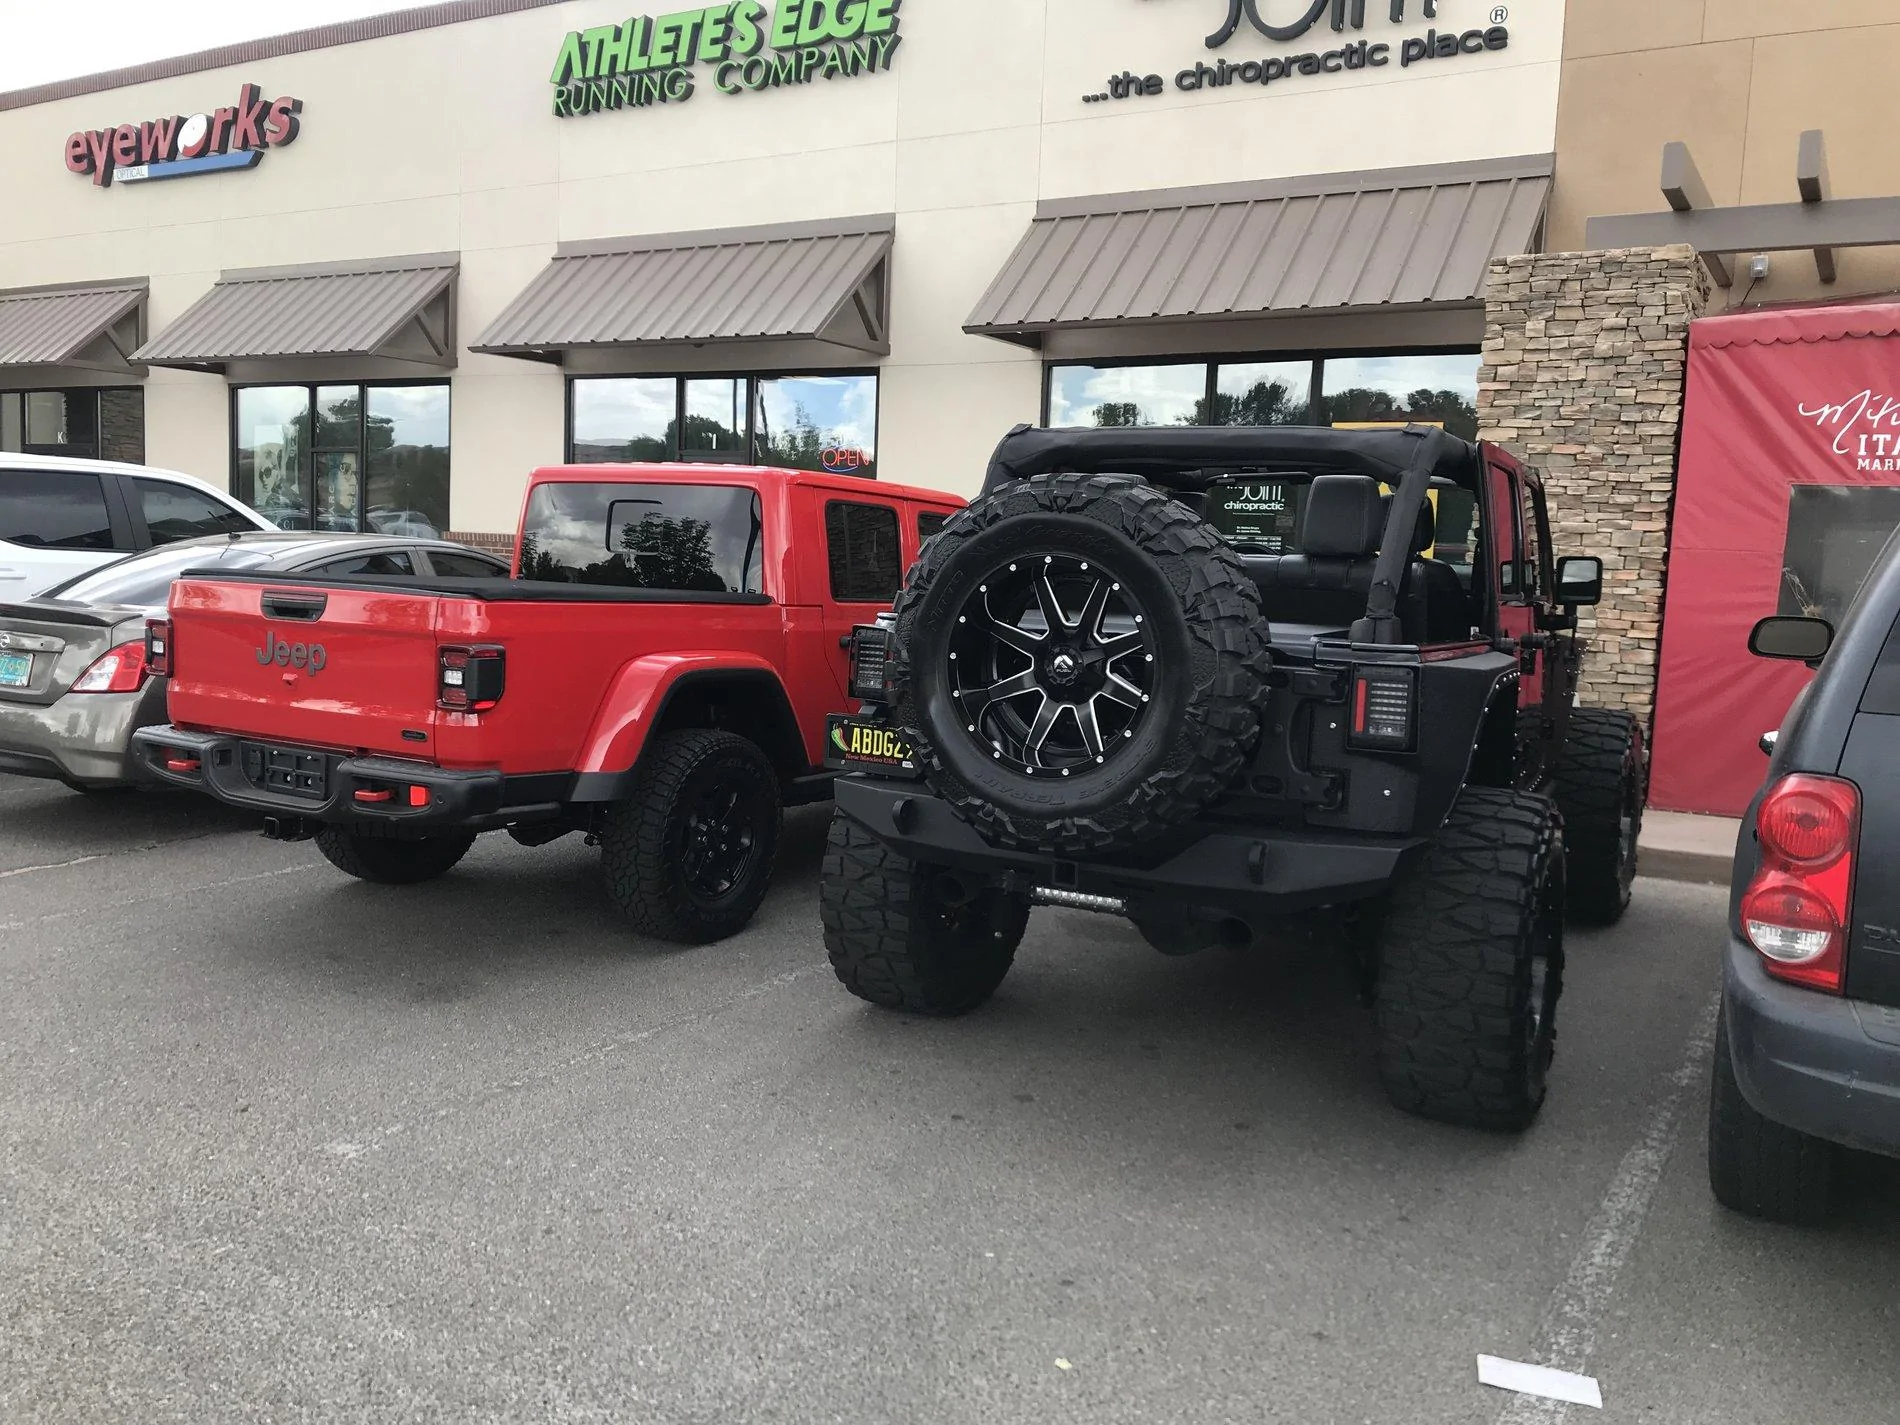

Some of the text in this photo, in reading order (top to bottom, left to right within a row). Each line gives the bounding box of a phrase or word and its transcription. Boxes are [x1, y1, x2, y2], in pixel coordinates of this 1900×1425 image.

[550, 0, 902, 86] ATHLETE'S EDGE
[1174, 39, 1389, 91] chiropractic
[1401, 25, 1509, 67] place
[551, 33, 903, 118] RUNNING COMPANY
[65, 83, 303, 188] eyeworks
[116, 167, 145, 179] OPTICAL
[822, 448, 870, 466] OPEN
[1224, 500, 1285, 512] chiropractic
[255, 630, 327, 677] Jeep
